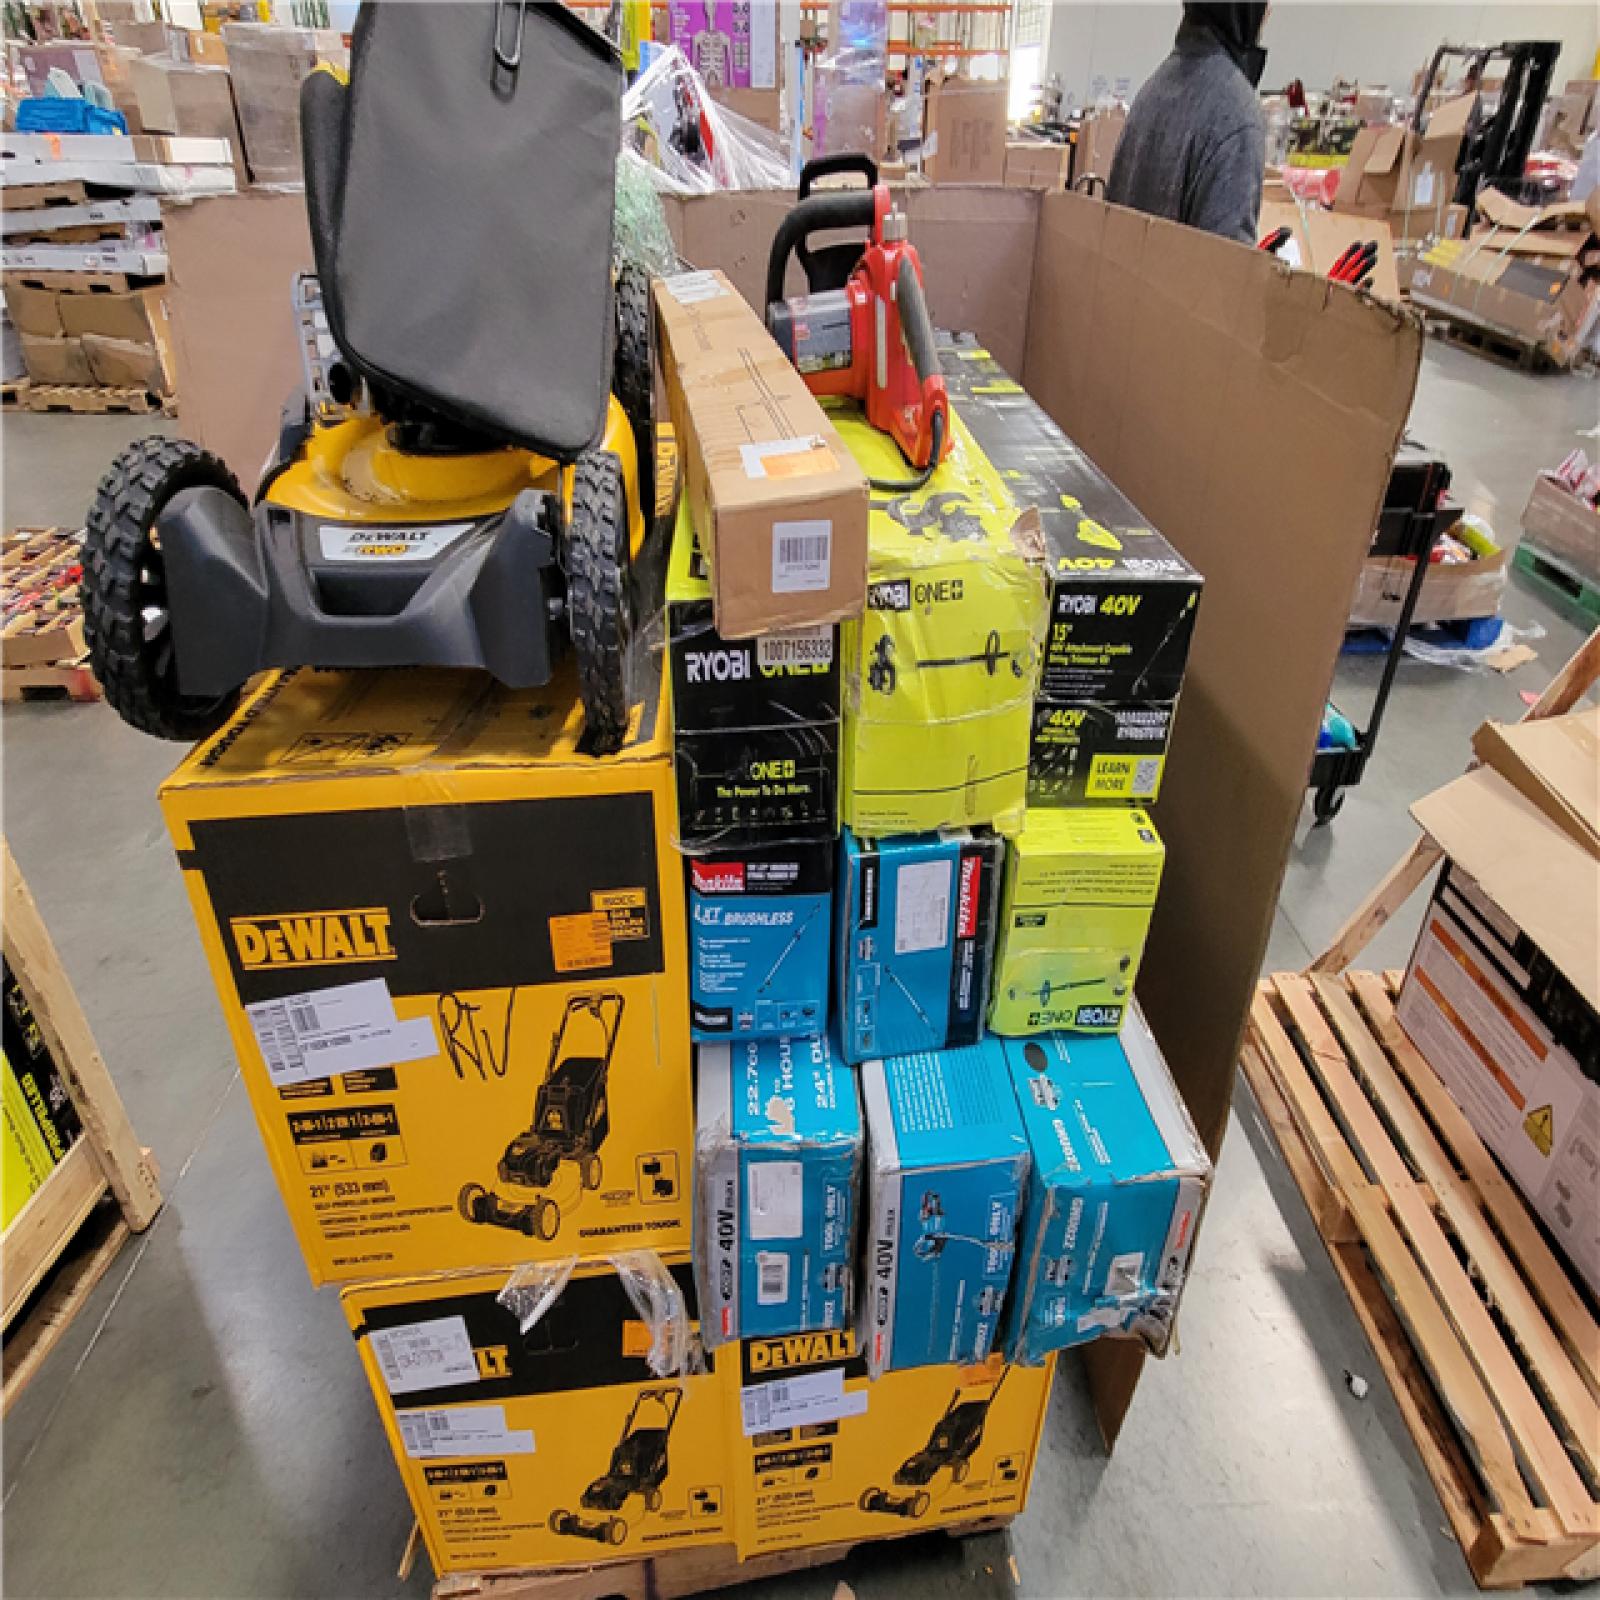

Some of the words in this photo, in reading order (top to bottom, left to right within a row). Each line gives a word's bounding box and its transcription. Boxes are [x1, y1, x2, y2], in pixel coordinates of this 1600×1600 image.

[1057, 594, 1098, 616] RYOBI
[1099, 594, 1144, 616] 40V
[683, 649, 751, 684] RYOBI
[1049, 709, 1087, 726] 40V
[1096, 761, 1131, 774] LEARN
[1094, 777, 1126, 791] MORE
[717, 1209, 735, 1251] 40V
[876, 1239, 894, 1281] 40V
